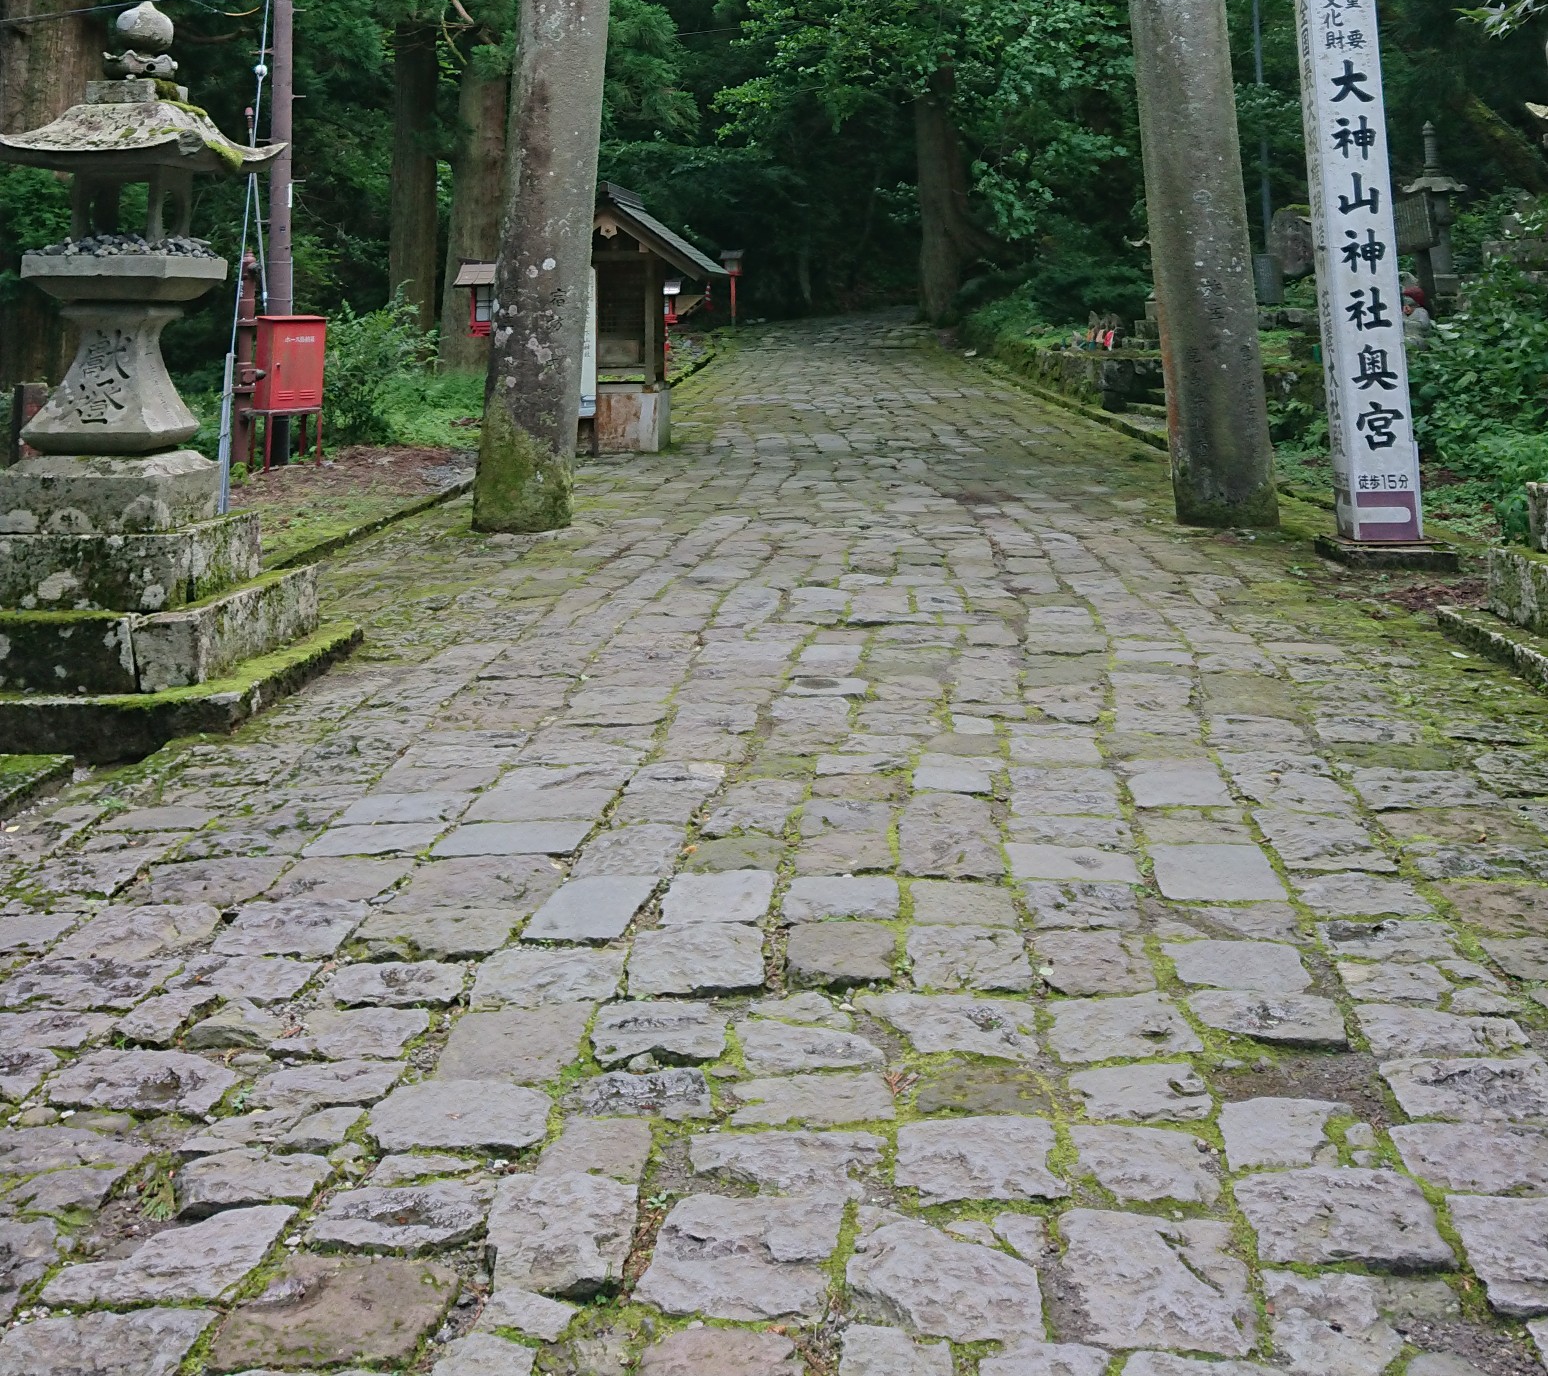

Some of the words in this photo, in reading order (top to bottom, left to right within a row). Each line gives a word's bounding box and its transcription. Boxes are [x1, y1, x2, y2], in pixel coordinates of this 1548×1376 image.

[1329, 58, 1405, 451] 大神山神社奥宮
[1357, 474, 1409, 490] 徒歩15分
